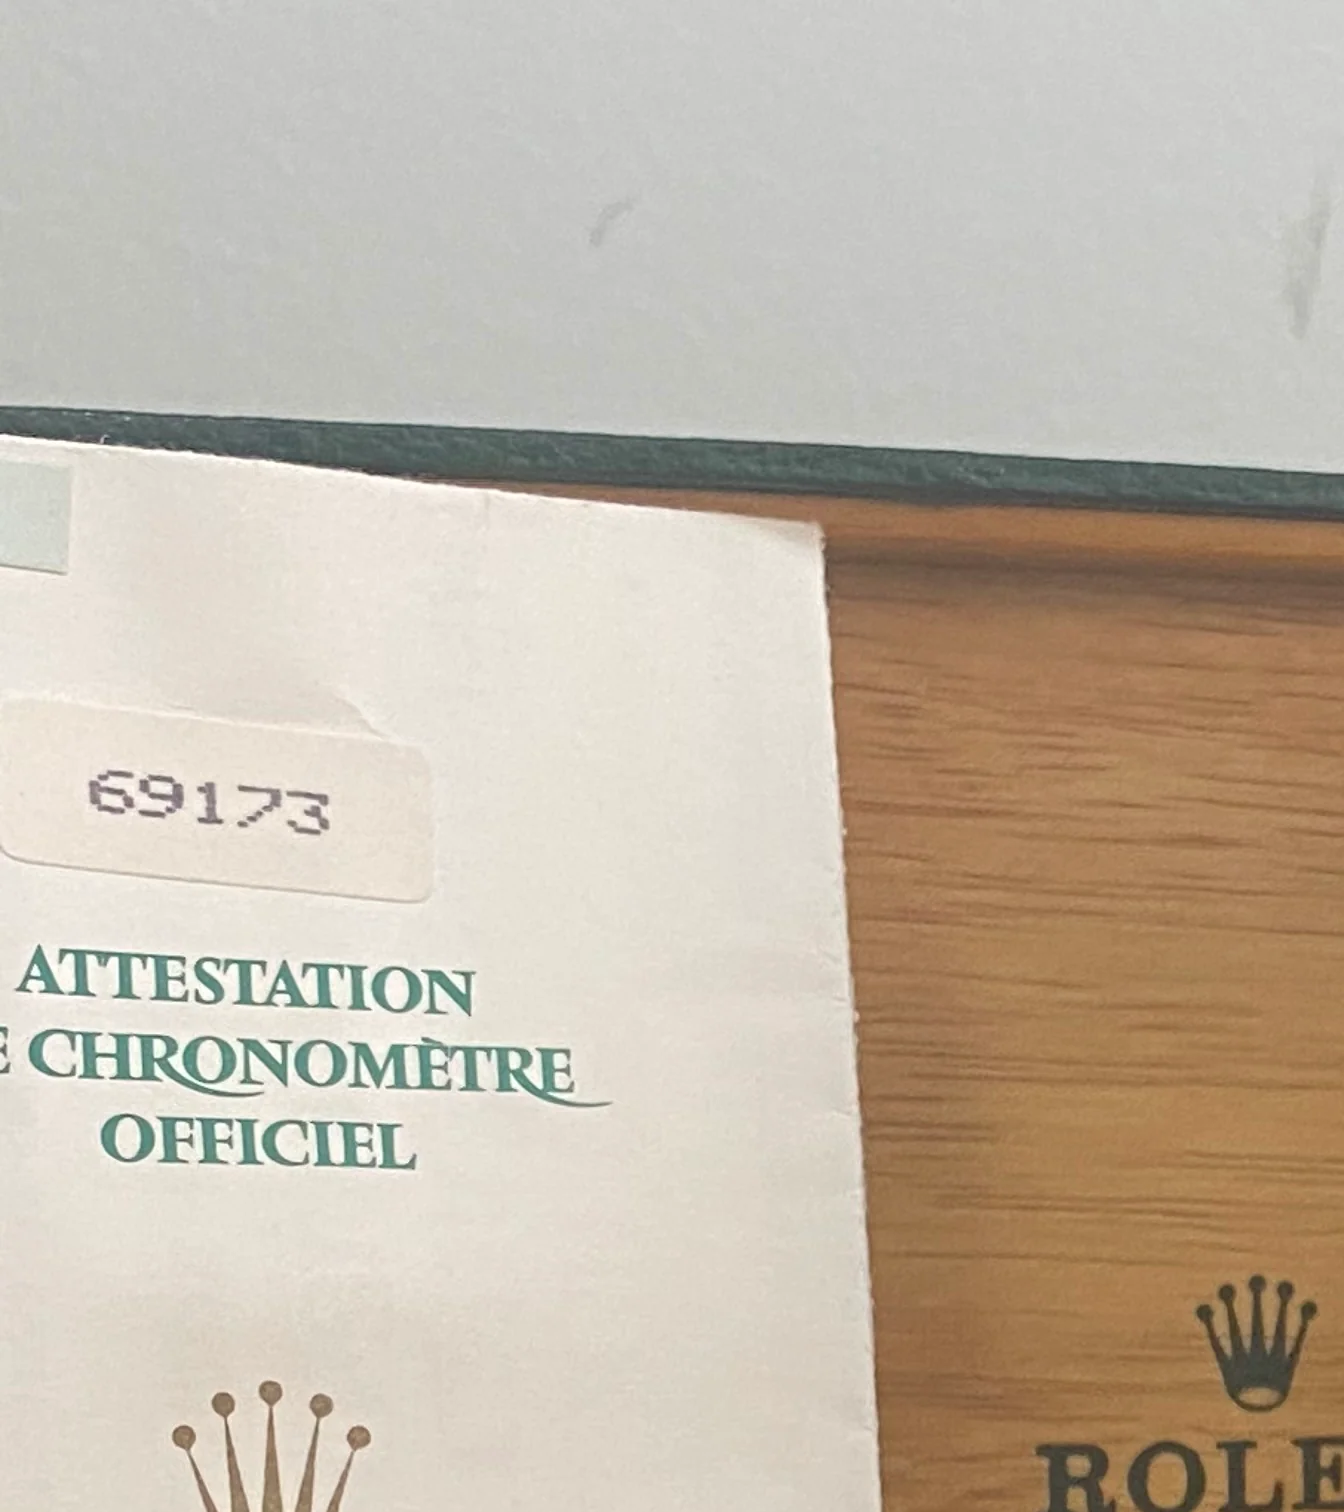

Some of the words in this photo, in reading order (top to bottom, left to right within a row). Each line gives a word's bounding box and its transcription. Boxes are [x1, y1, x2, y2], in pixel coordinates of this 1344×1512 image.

[88, 769, 331, 836] 69173
[14, 943, 478, 1018] ATTESTATION
[28, 1027, 614, 1108] CHRONOMÈTRE
[99, 1112, 418, 1171] OFFICIEL
